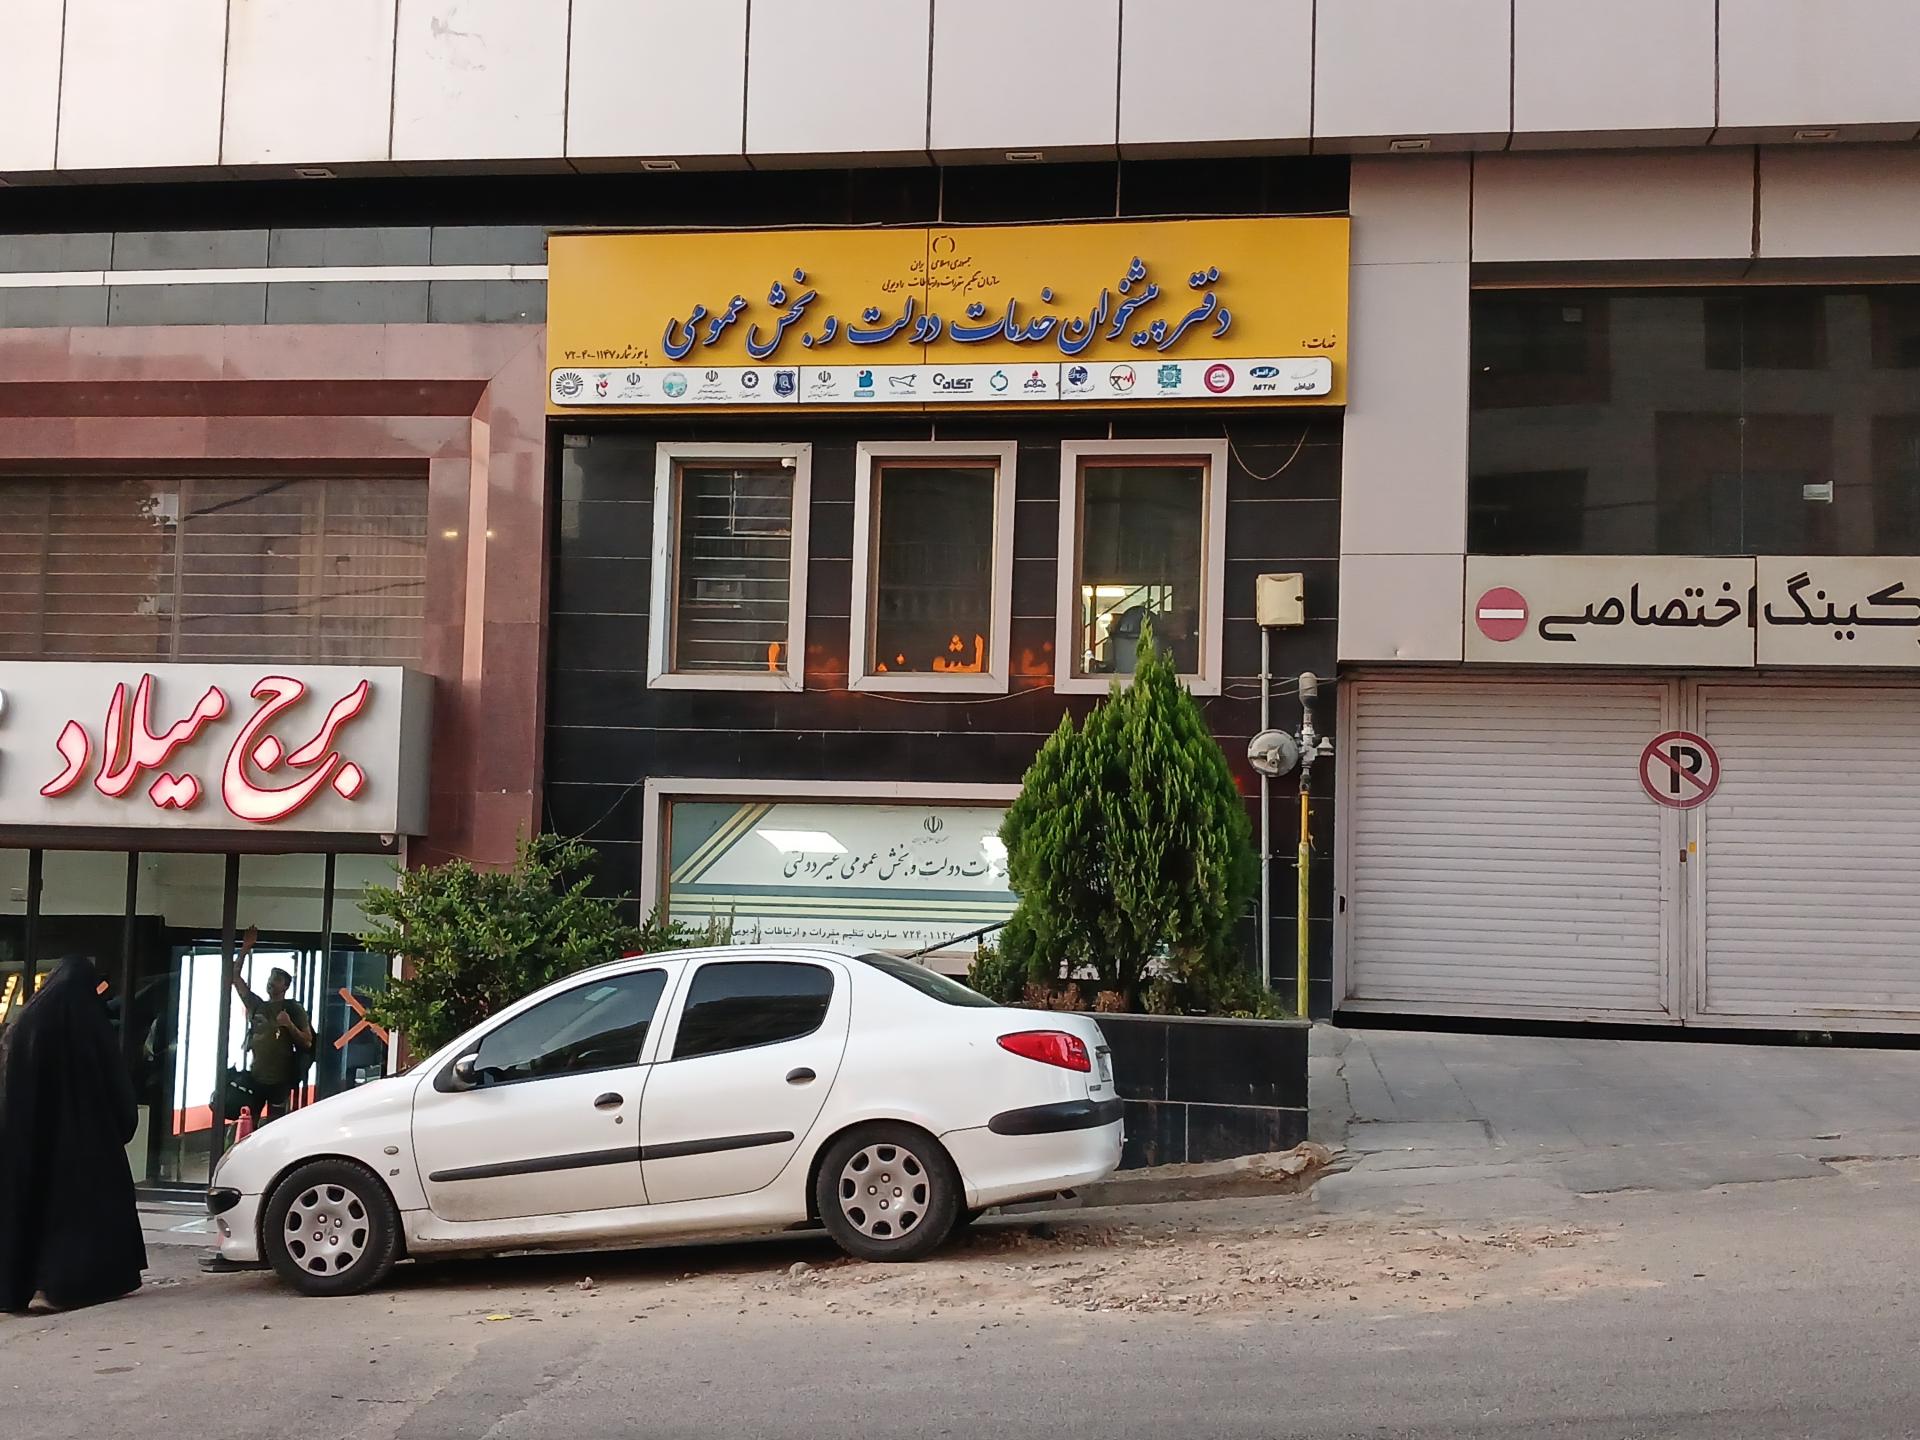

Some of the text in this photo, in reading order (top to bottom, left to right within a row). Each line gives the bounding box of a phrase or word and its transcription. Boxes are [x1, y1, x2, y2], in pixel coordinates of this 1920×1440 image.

[661, 255, 1232, 361] دفتر پیشخوان خدمات دولت و بخش عمومی
[1252, 383, 1277, 391] MTN
[1538, 571, 1920, 647] کینگ اختصاصی
[40, 672, 374, 824] برج میلاد
[783, 850, 817, 879] دولتی
[841, 852, 878, 880] عمومی
[878, 843, 910, 881] بخش
[919, 856, 961, 877] دولت
[764, 926, 800, 938] ارتباطات
[809, 928, 840, 940] مقررات
[842, 930, 864, 941] تنظیم
[867, 931, 897, 940] سازمان
